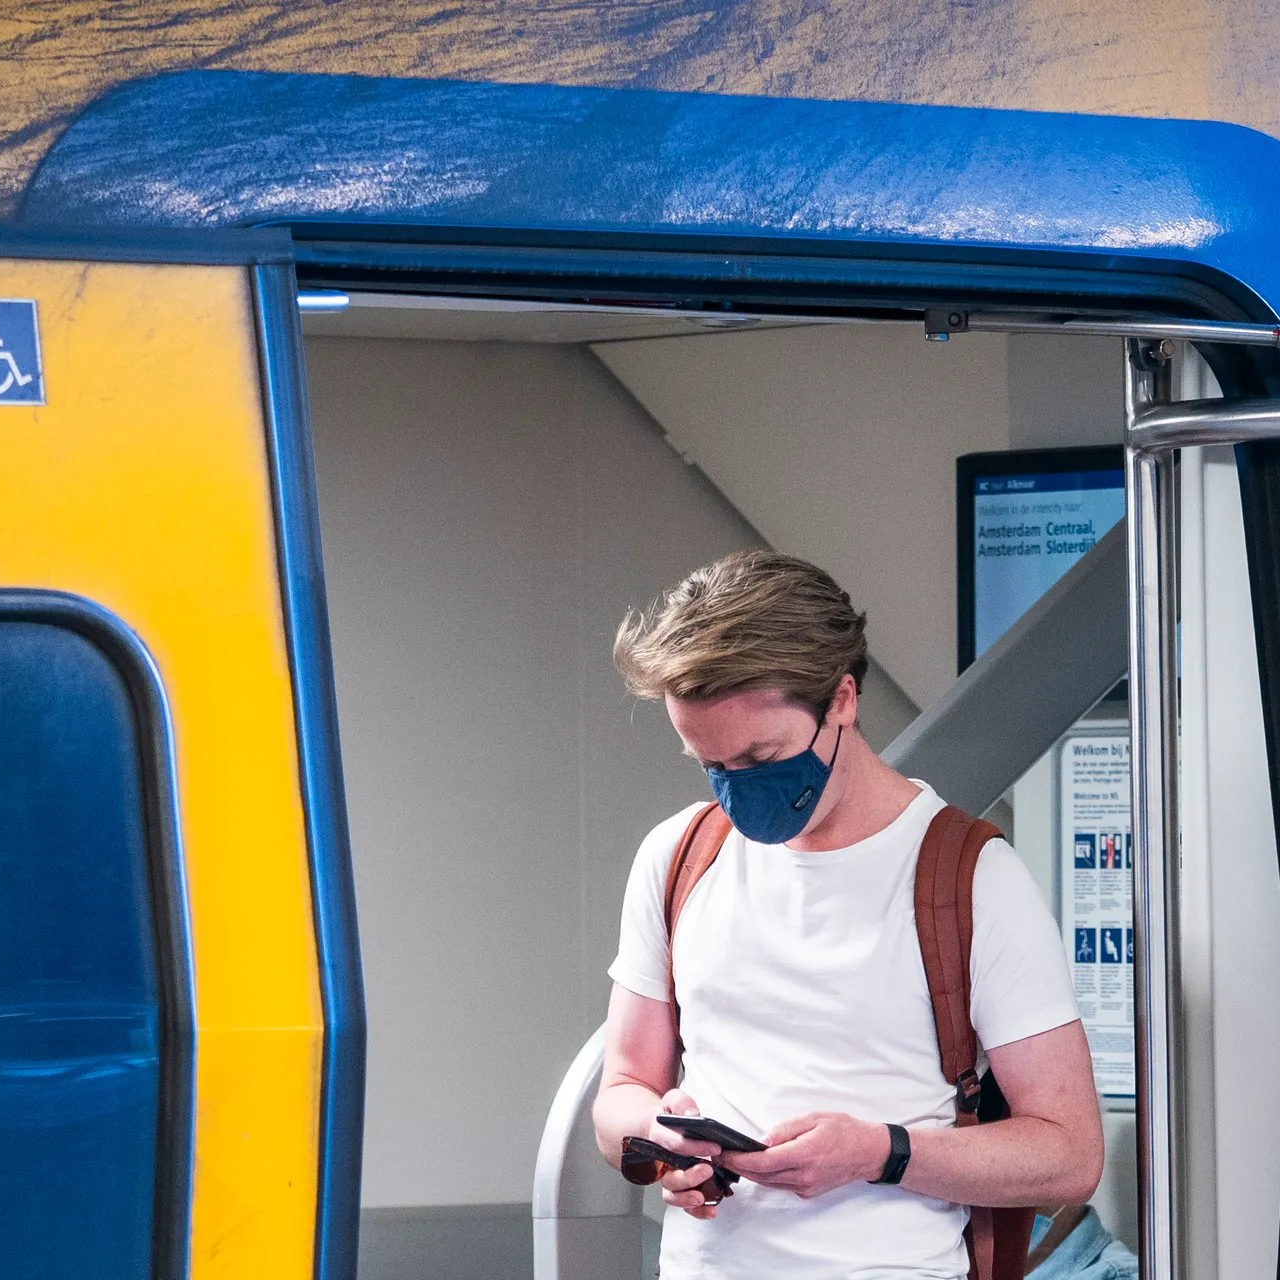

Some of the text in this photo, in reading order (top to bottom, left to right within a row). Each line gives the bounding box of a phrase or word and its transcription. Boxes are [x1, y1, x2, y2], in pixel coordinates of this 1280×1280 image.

[978, 519, 1096, 538] Amsterdam Centraal,
[978, 538, 1096, 556] Amsterdam Sloterdij
[1073, 745, 1109, 755] Welkom
[1111, 744, 1123, 759] bij
